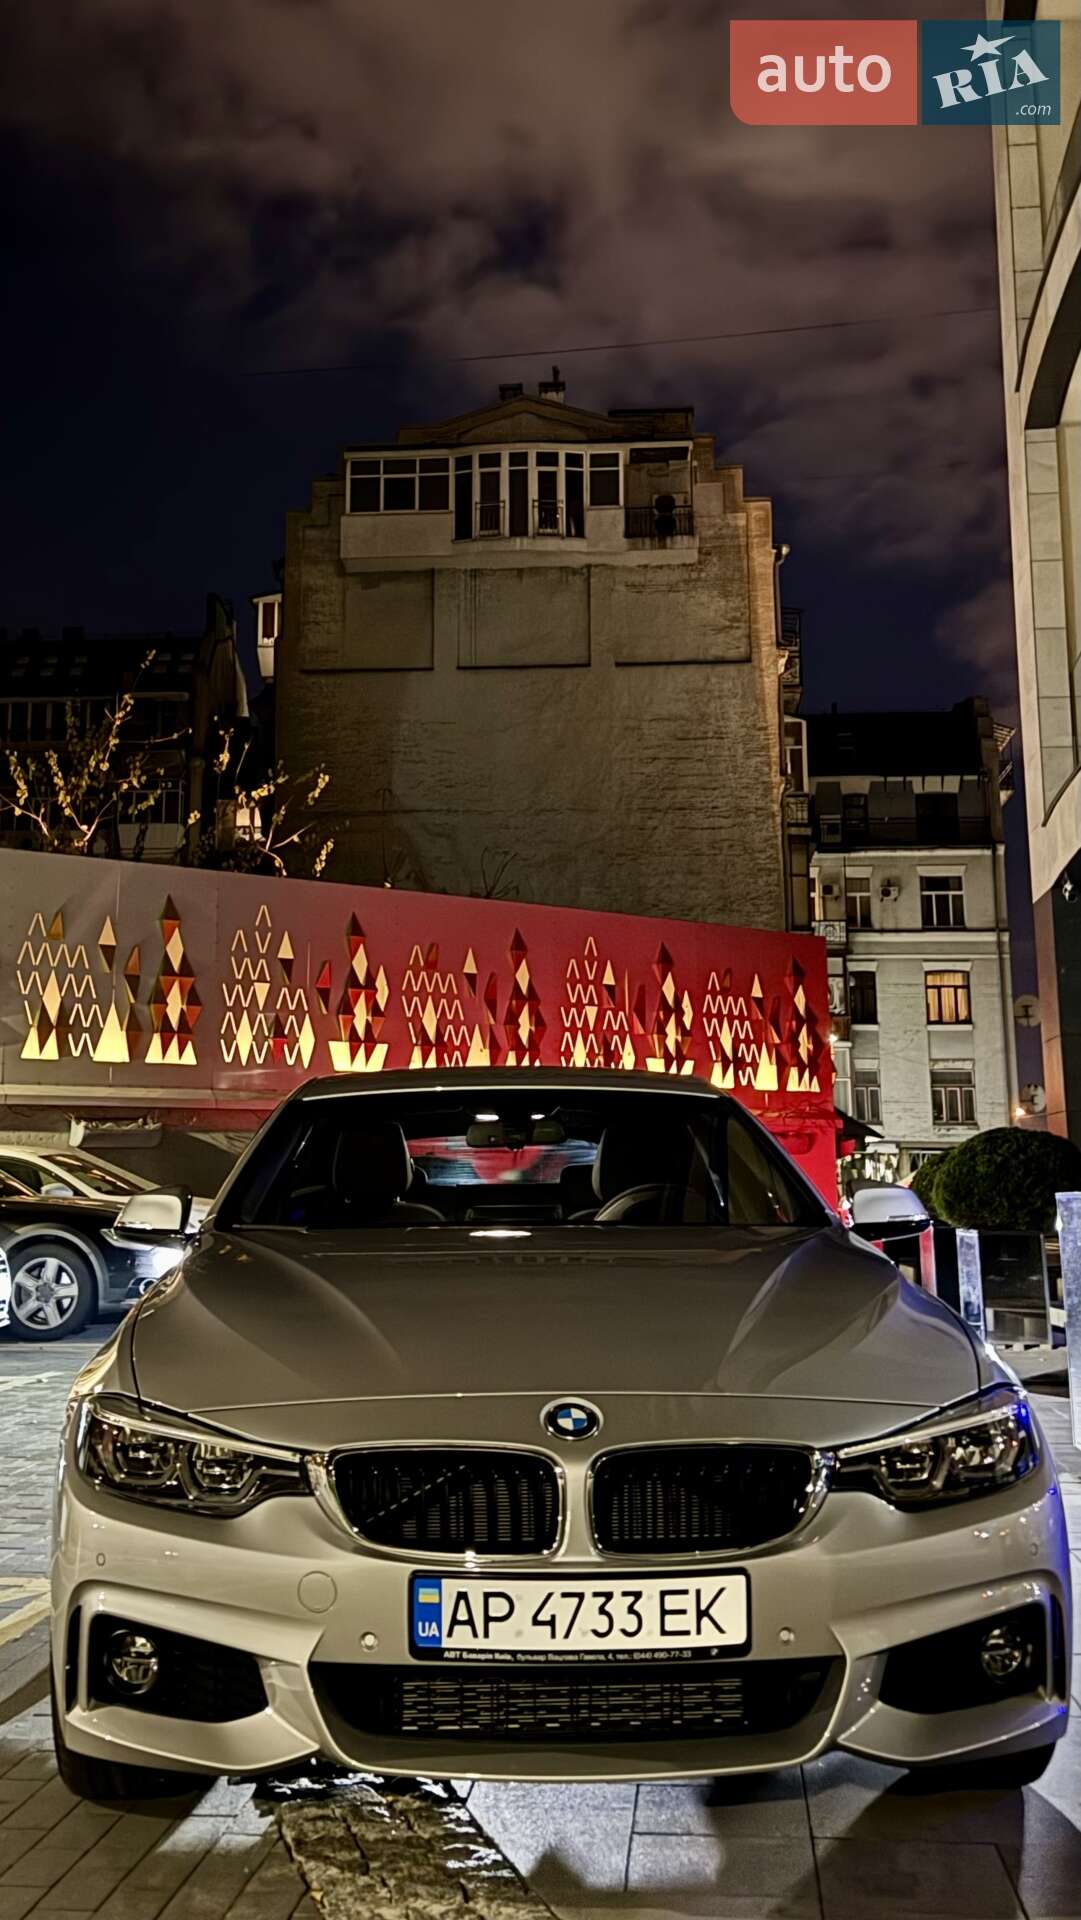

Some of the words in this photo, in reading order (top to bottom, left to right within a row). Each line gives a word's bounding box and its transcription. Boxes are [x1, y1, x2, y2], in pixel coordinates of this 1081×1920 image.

[418, 1621, 440, 1638] UA
[446, 1590, 515, 1639] AP
[532, 1590, 644, 1639] 4733
[659, 1587, 727, 1637] EK
